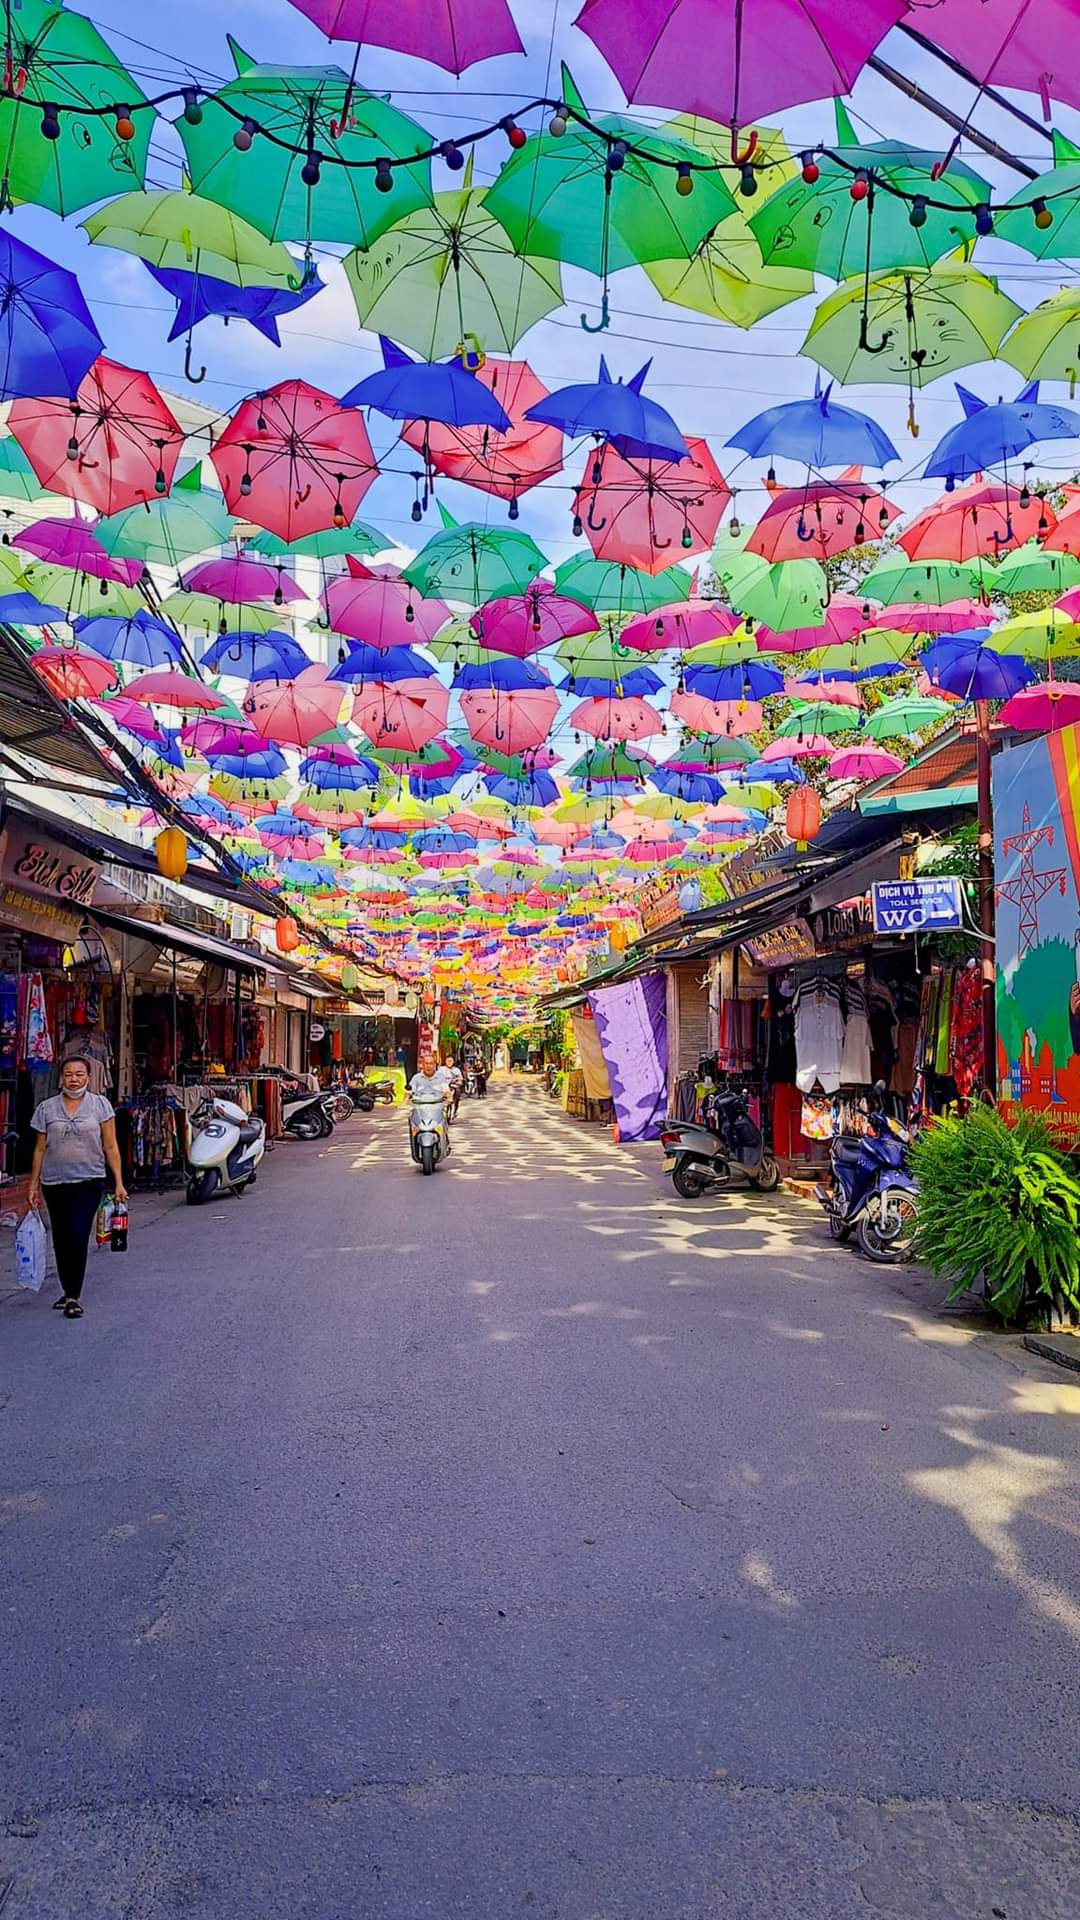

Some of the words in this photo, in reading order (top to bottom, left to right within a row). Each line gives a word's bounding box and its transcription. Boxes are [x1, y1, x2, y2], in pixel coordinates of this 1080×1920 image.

[879, 887, 900, 899] DỊCH
[902, 885, 914, 898] VỤ
[917, 884, 934, 895] THU
[911, 897, 942, 905] SERVICE
[880, 908, 928, 927] WC
